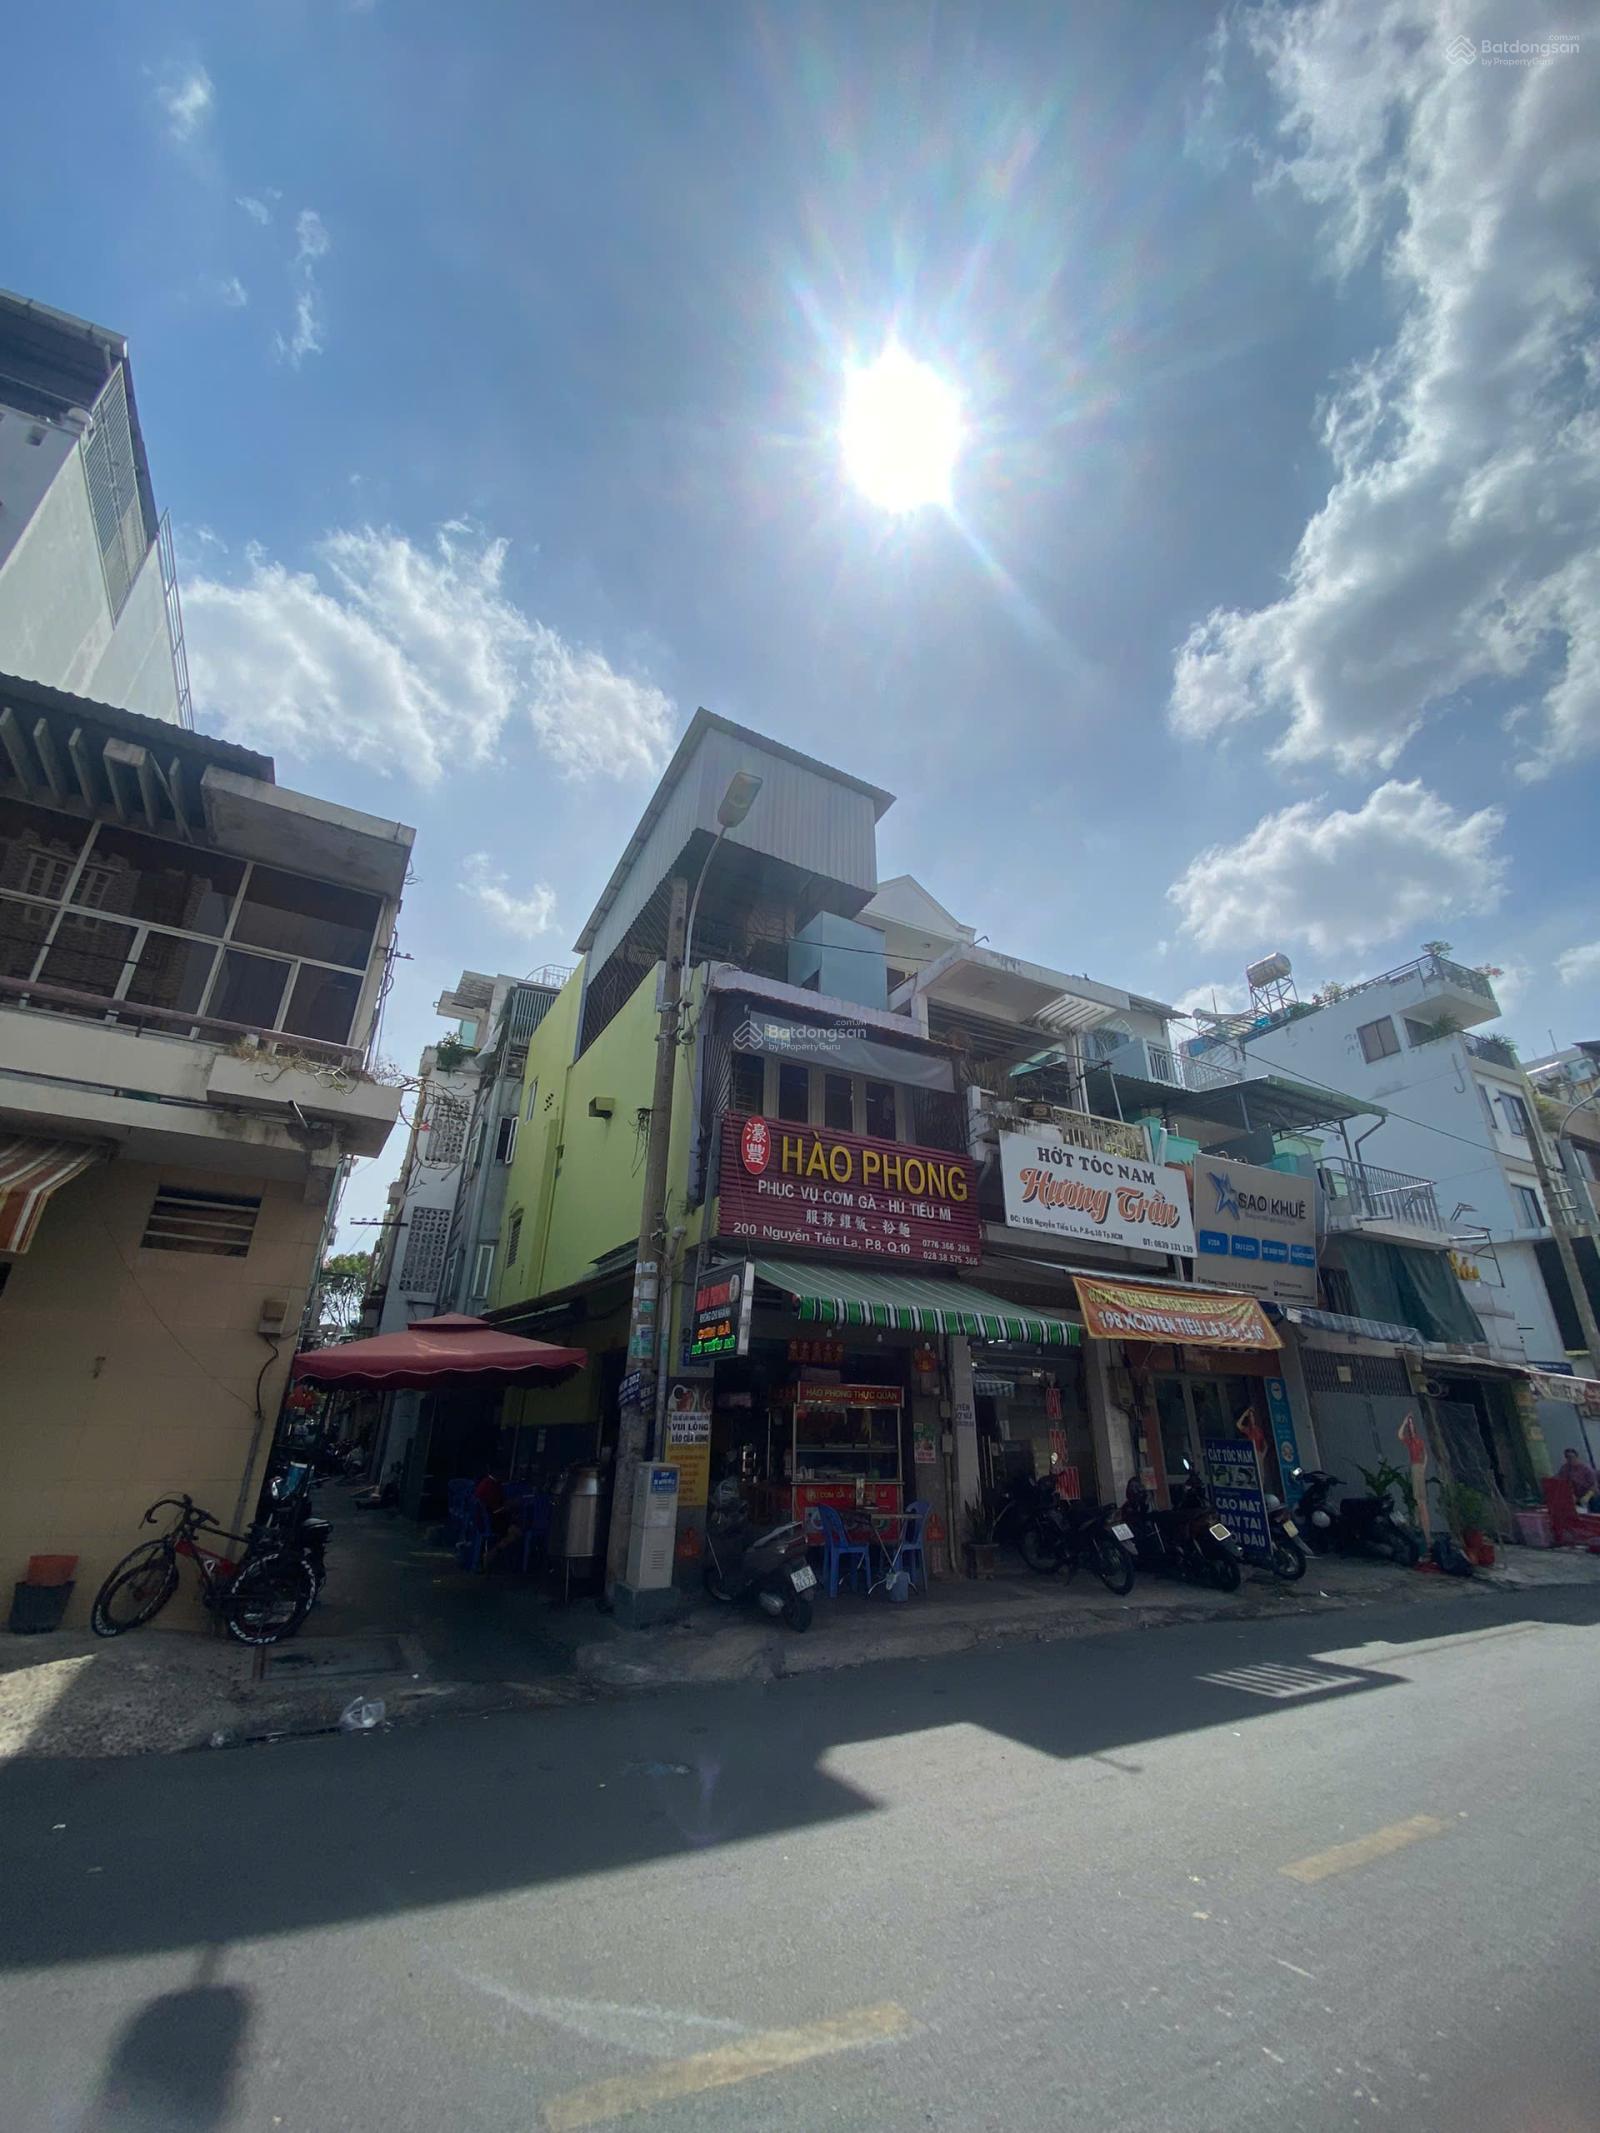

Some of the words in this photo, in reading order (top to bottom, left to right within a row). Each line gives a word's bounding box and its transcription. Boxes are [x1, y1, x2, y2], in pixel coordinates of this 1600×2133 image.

[782, 1130, 852, 1183] HÀO
[862, 1150, 968, 1201] PHONG
[1037, 1146, 1074, 1167] HỚT
[1079, 1154, 1114, 1175] TÓC
[1117, 1165, 1156, 1185] NAM
[758, 1179, 794, 1199] PHỤC
[800, 1186, 818, 1204] VỤ
[823, 1190, 853, 1207] CƠM
[858, 1193, 876, 1210] GÀ
[1019, 1167, 1112, 1224] Hương
[1115, 1186, 1181, 1228] Trần
[1238, 1192, 1267, 1212] SAO
[1271, 1198, 1306, 1220] KHUÊ
[733, 1222, 757, 1235] 200
[763, 1225, 810, 1242] Nguyễn
[843, 1235, 861, 1249] La,
[888, 1242, 911, 1255] Q.10
[923, 1251, 937, 1260] 028
[1098, 1311, 1123, 1329] 198
[672, 1423, 686, 1431] VUI
[688, 1422, 709, 1431] LÒNG
